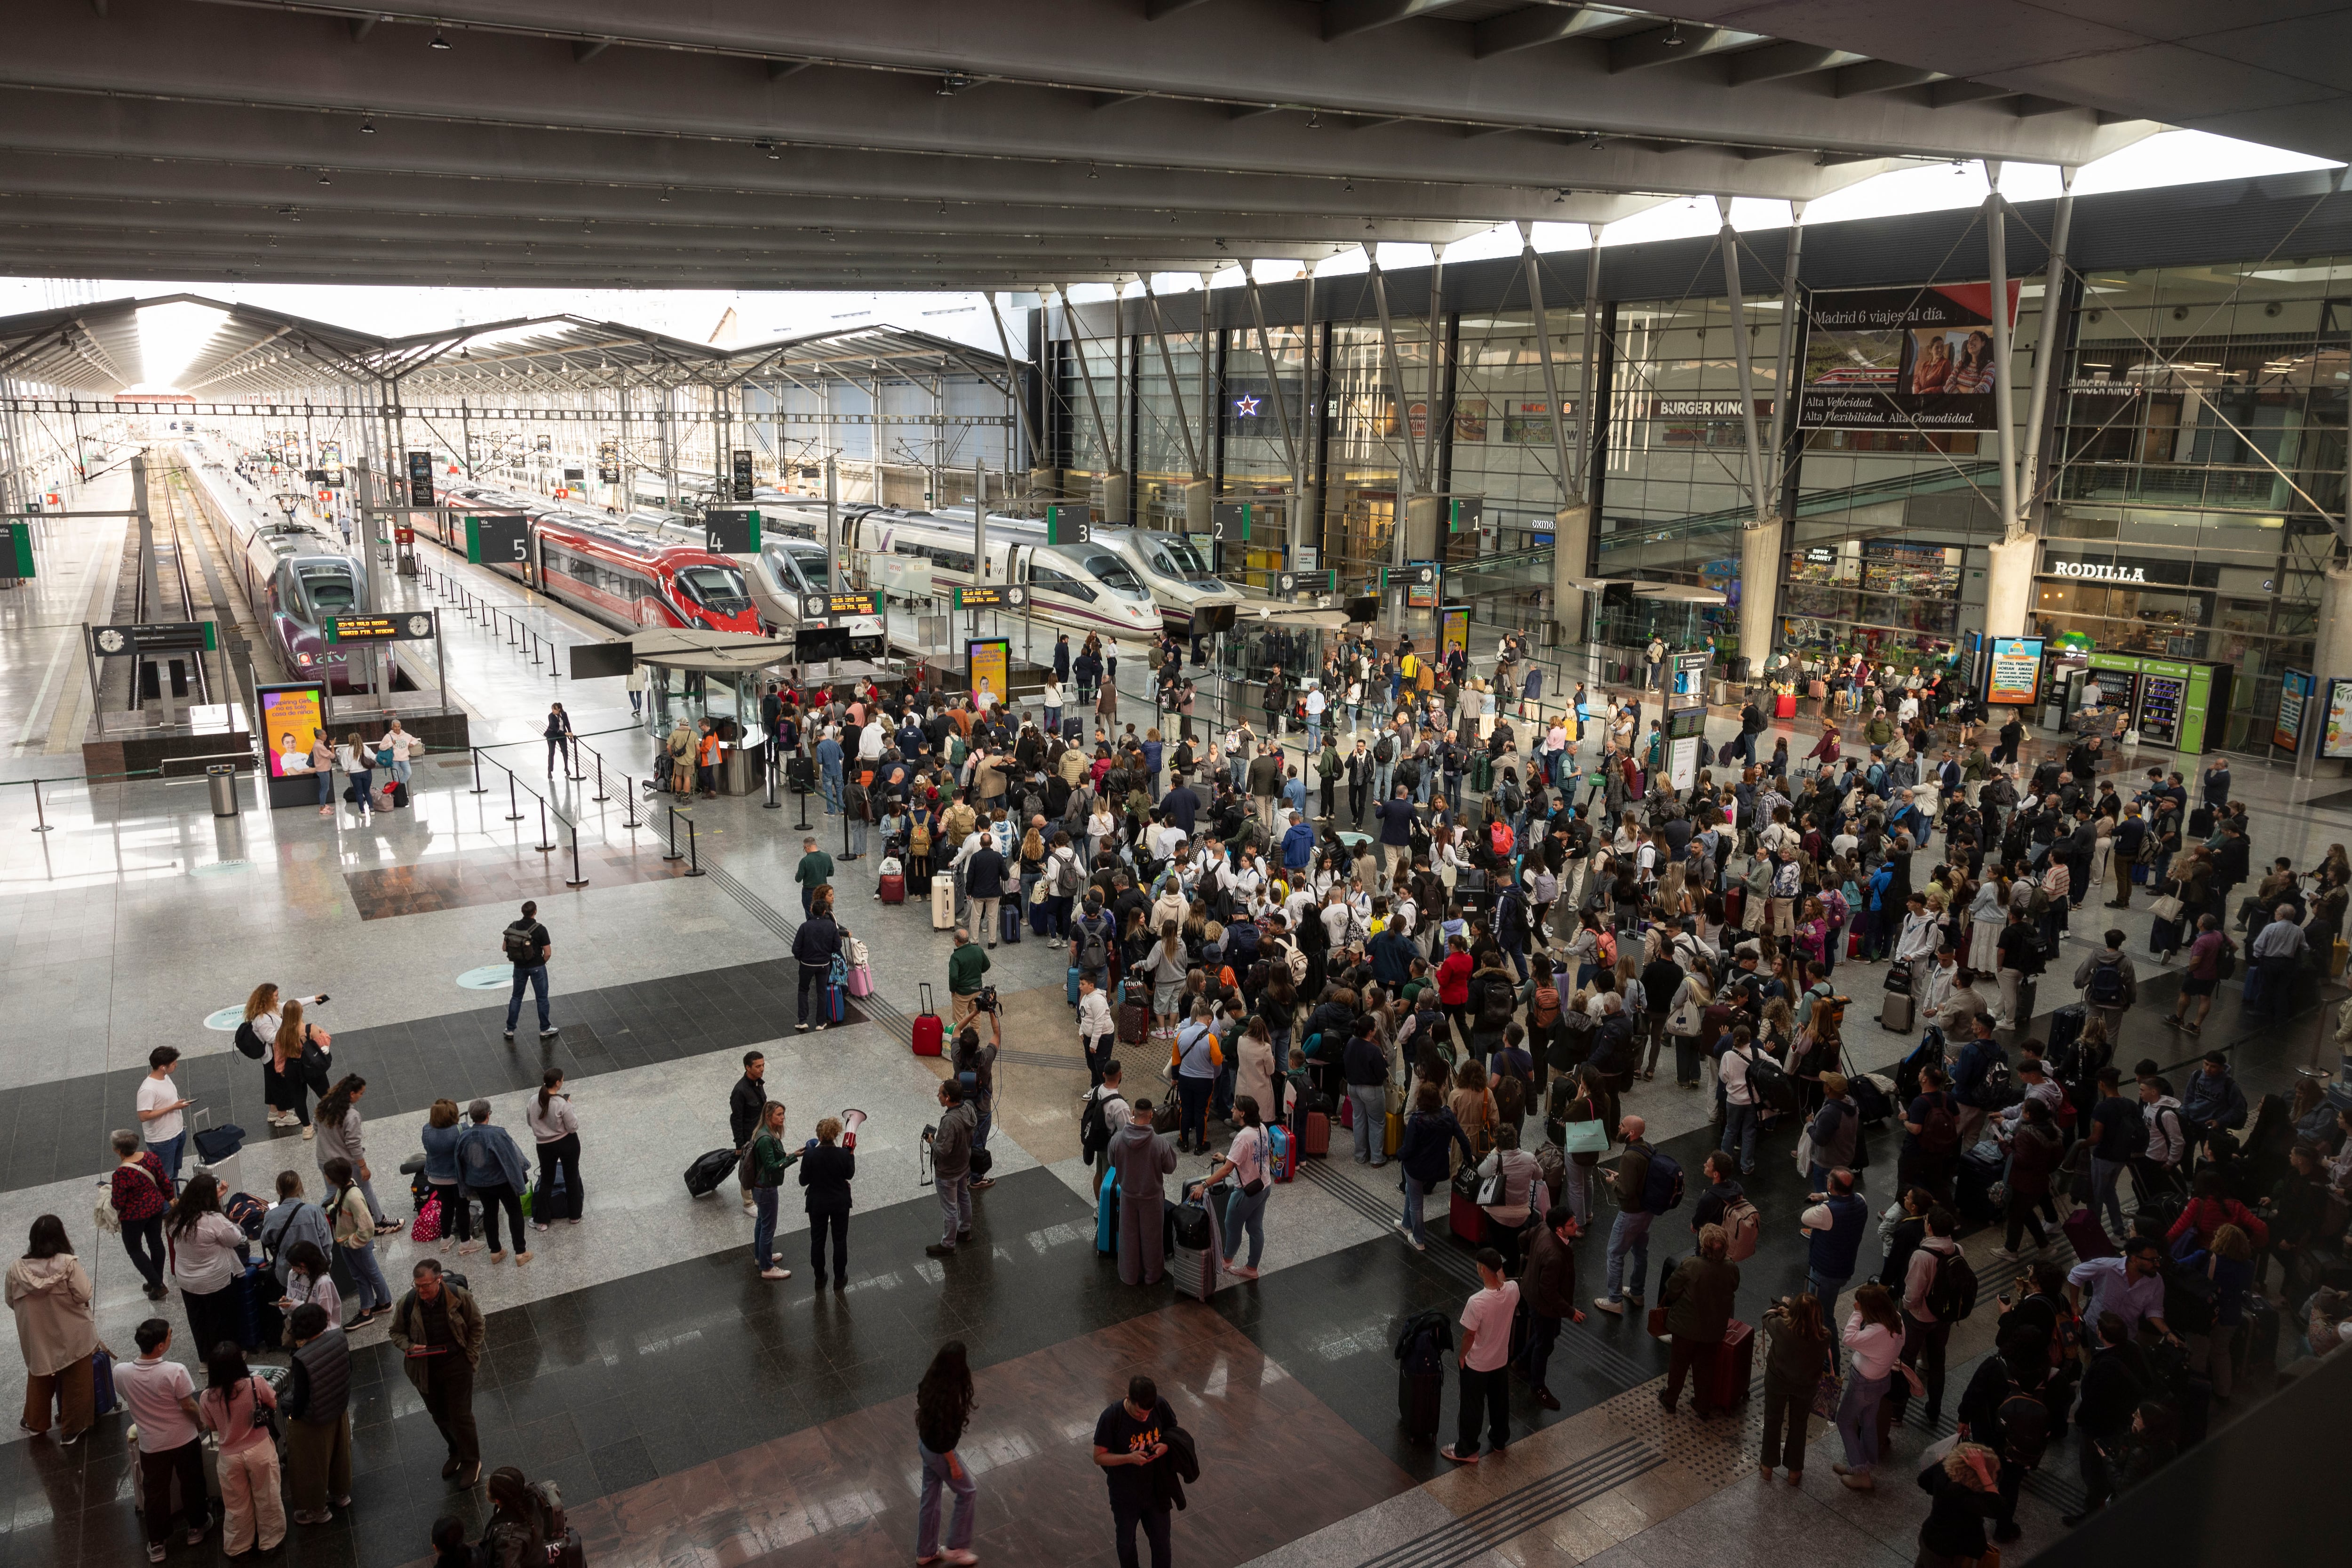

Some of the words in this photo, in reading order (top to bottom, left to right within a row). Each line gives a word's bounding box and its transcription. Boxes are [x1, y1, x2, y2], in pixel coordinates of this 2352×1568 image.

[1815, 311, 1856, 324] Madrid
[1859, 310, 1866, 323] 6
[1869, 310, 1904, 325] viajes
[1907, 308, 1919, 321] al
[1923, 307, 1946, 320] día.
[1661, 401, 1711, 414] BURGER
[1805, 398, 1824, 406] Alta
[1827, 397, 1873, 407] Velocidad.
[1804, 412, 1822, 421] Alta
[1825, 411, 1885, 422] Flexibilidad.
[1888, 413, 1908, 422] Alta
[1911, 413, 1974, 423] Comodidad.
[1215, 522, 1223, 539] 2
[1473, 516, 1480, 531] 1
[710, 532, 723, 552] 4
[1079, 525, 1088, 542] 3
[513, 539, 526, 560] 5
[2054, 561, 2145, 582] RODILLA
[642, 599, 657, 629] iryo
